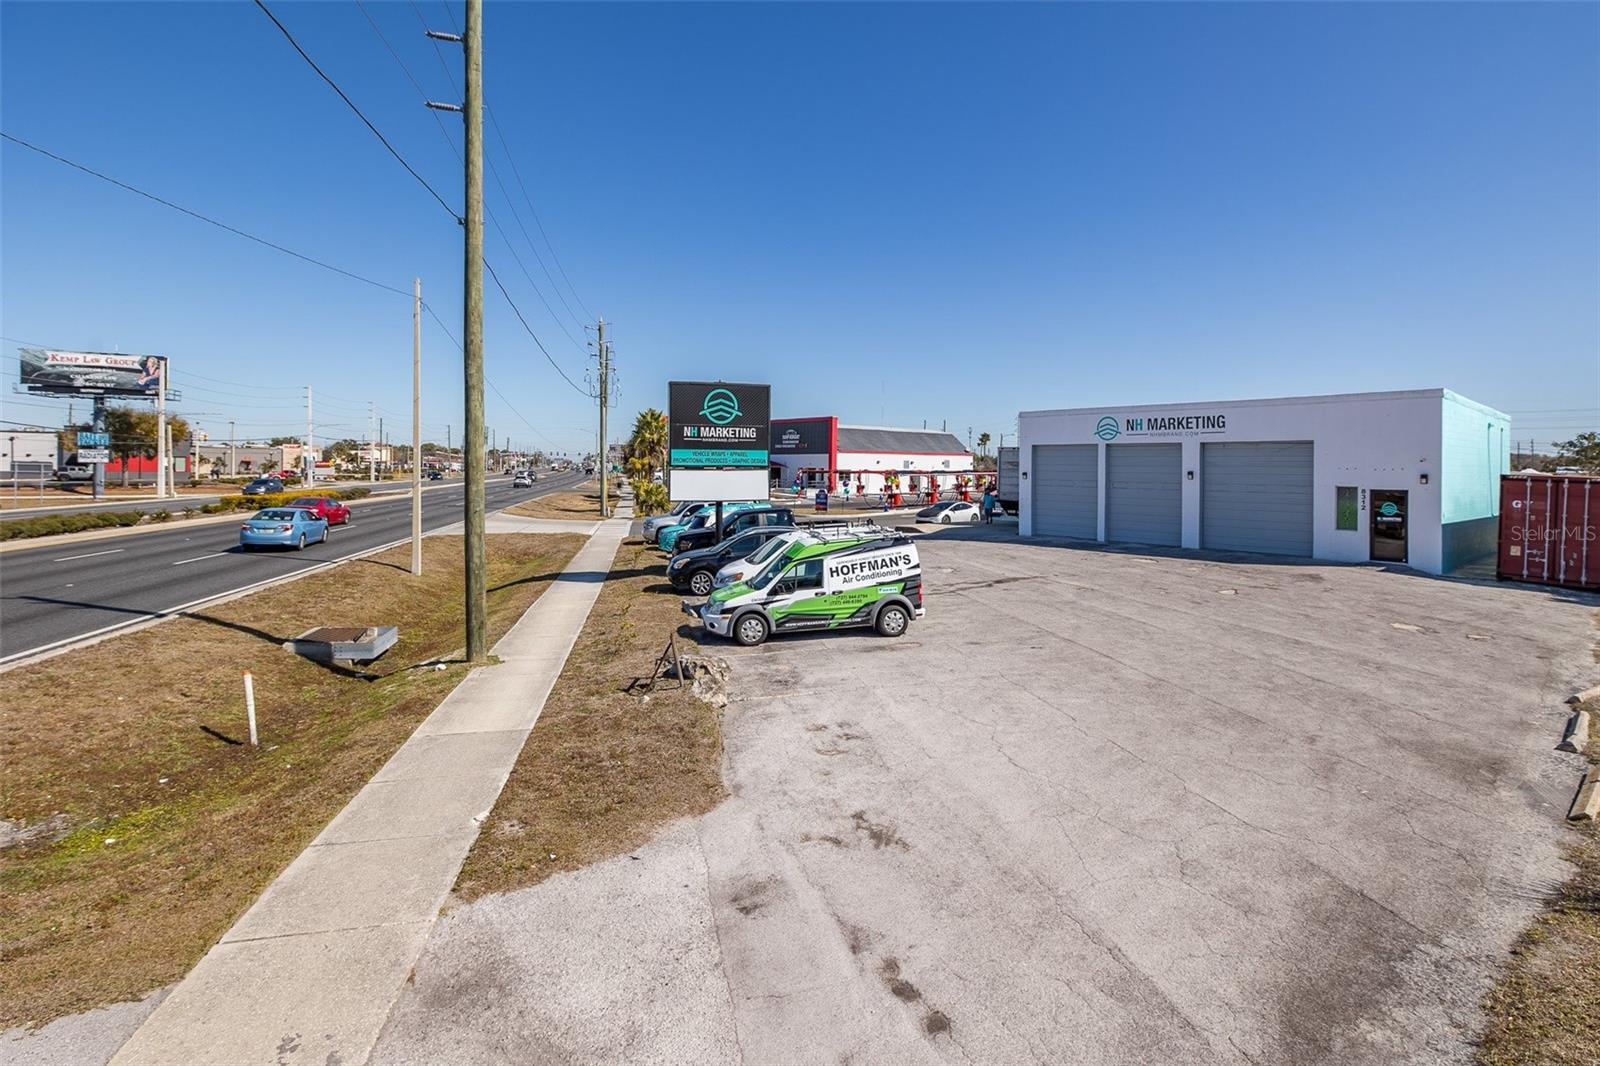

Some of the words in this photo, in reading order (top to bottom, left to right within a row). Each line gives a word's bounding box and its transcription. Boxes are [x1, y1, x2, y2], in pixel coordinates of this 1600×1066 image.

[1126, 418, 1143, 431] NH
[1147, 414, 1226, 430] MARKETING
[684, 426, 698, 437] NH
[700, 426, 756, 438] MARKETING
[830, 554, 912, 578] HOFFMAN'S
[842, 576, 854, 584] Air
[855, 568, 902, 582] Conditioning
